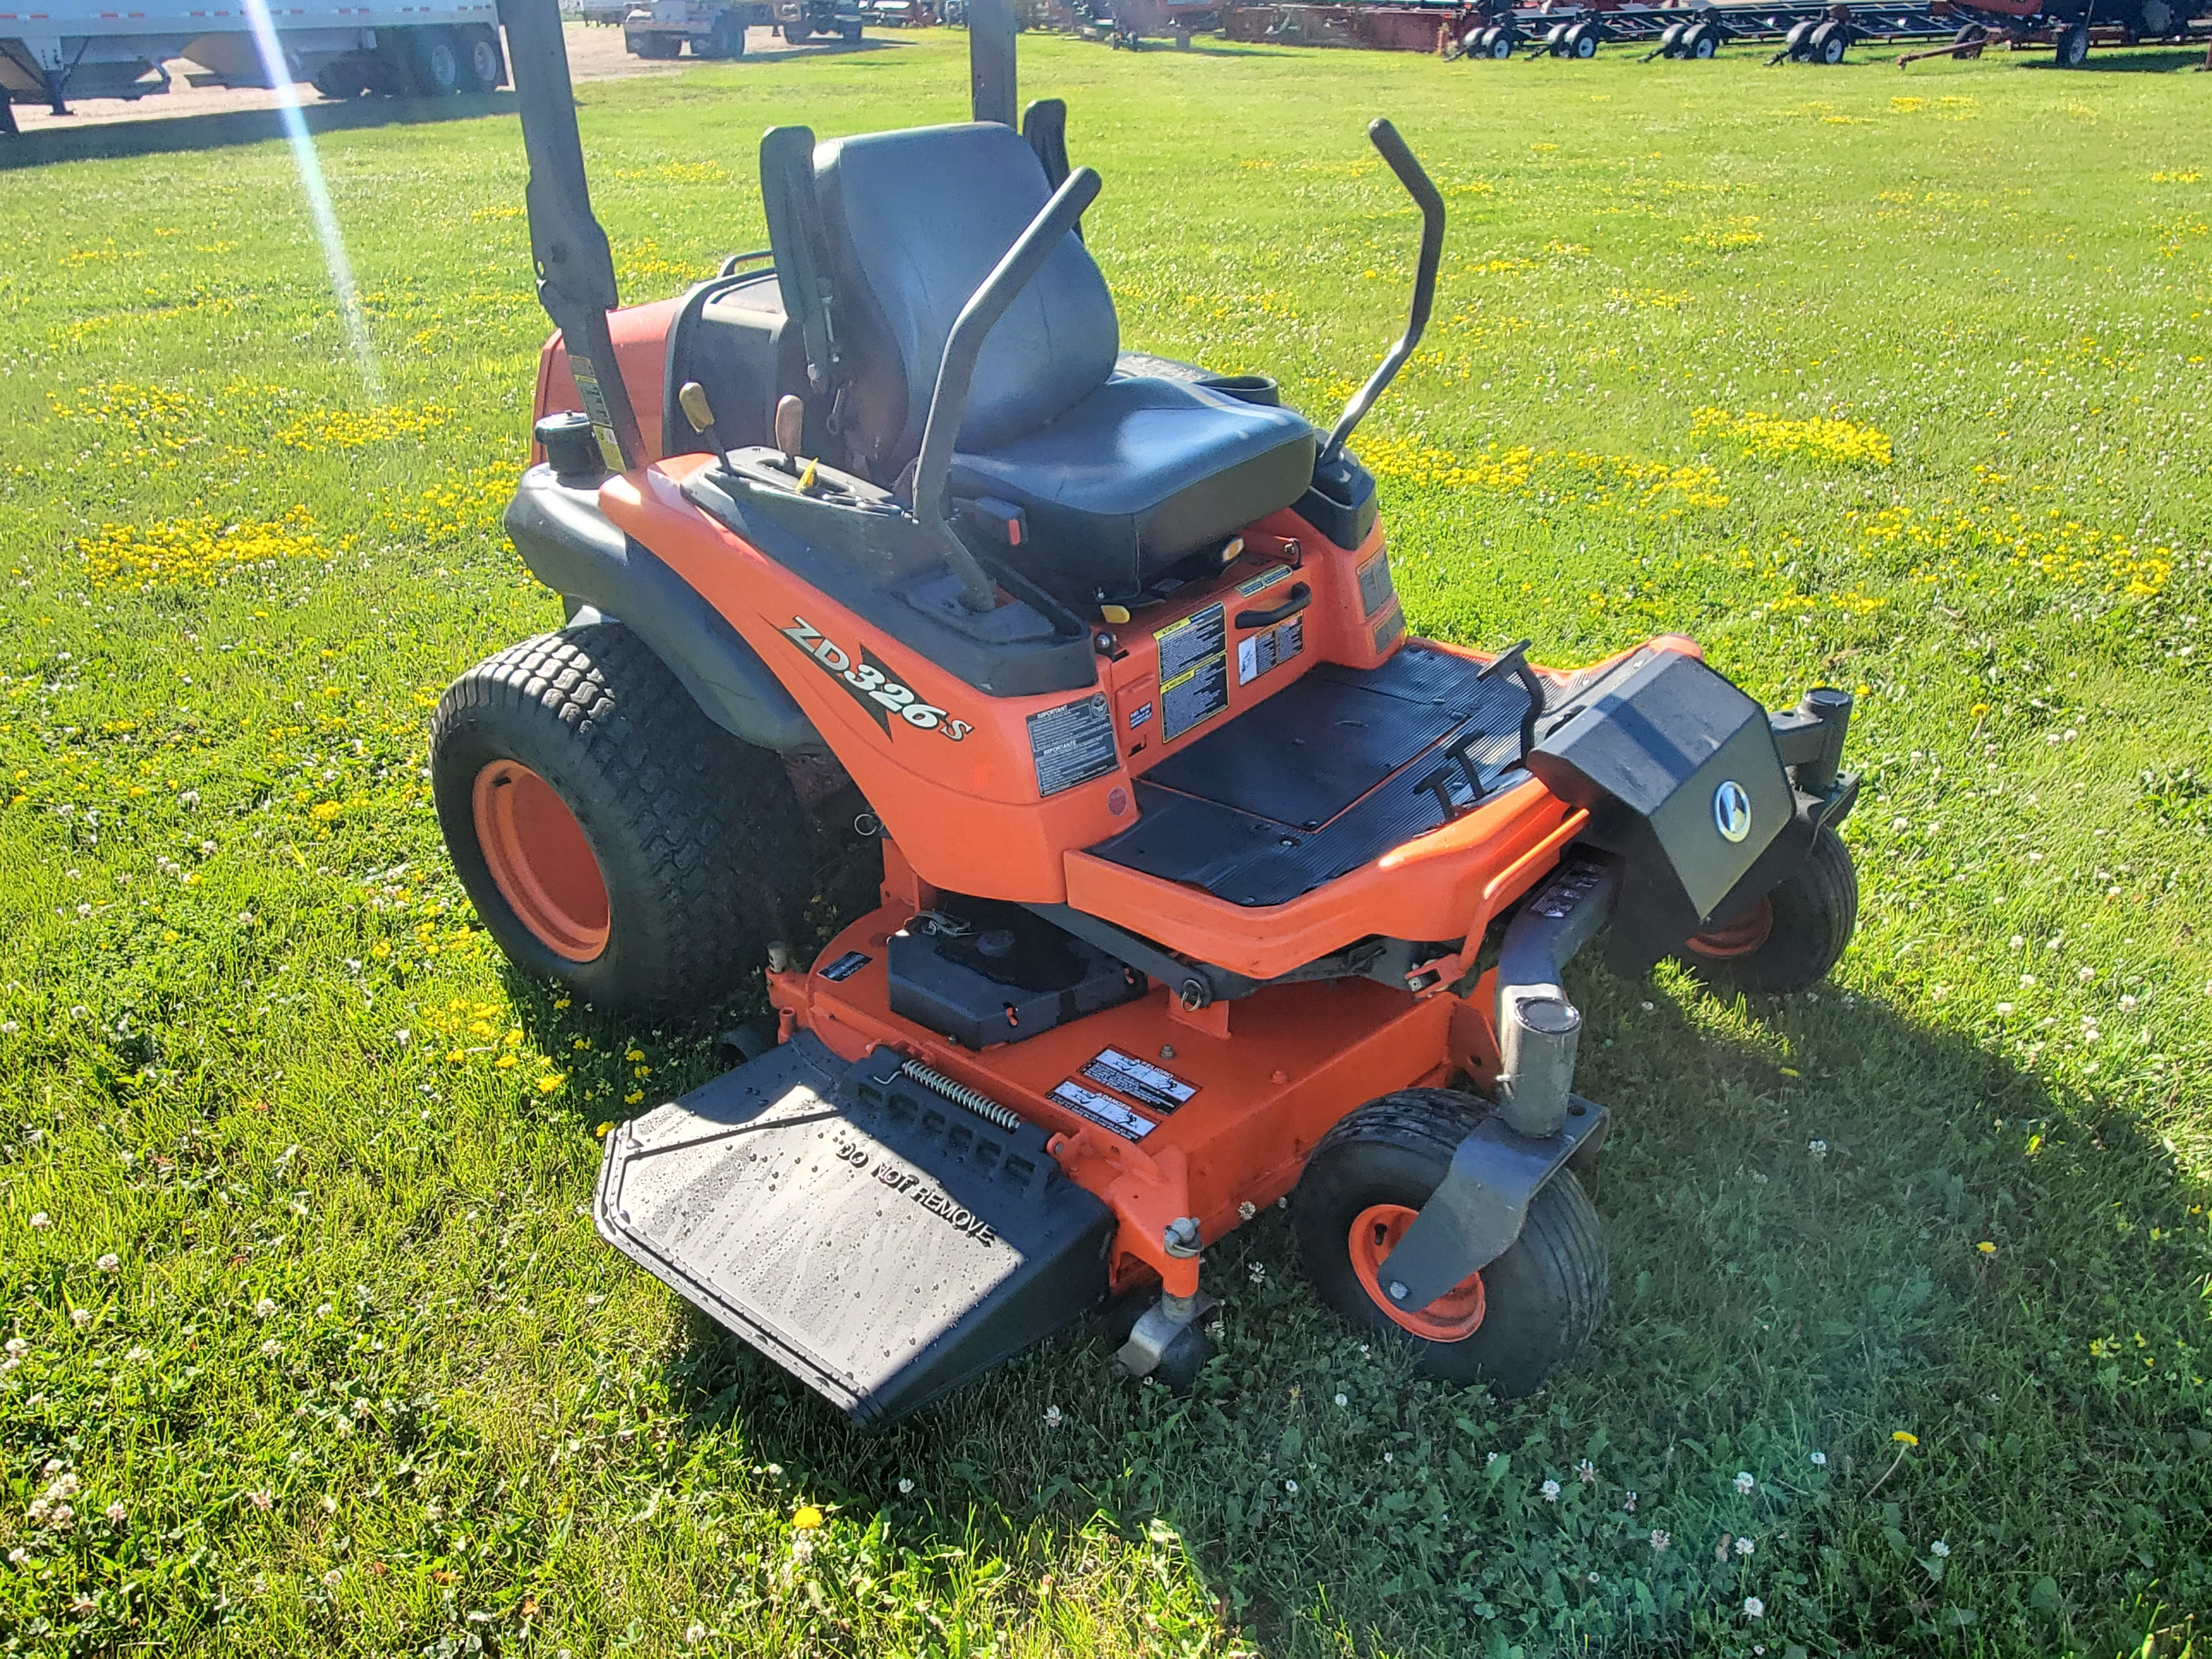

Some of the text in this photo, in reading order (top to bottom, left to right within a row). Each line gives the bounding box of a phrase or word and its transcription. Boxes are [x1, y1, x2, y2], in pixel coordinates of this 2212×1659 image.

[1037, 704, 1068, 719] IMPORTANT
[1141, 1061, 1174, 1079] PELIGRO
[1103, 1095, 1132, 1111] DANGER
[836, 1142, 998, 1248] DO NOT REMOVE
